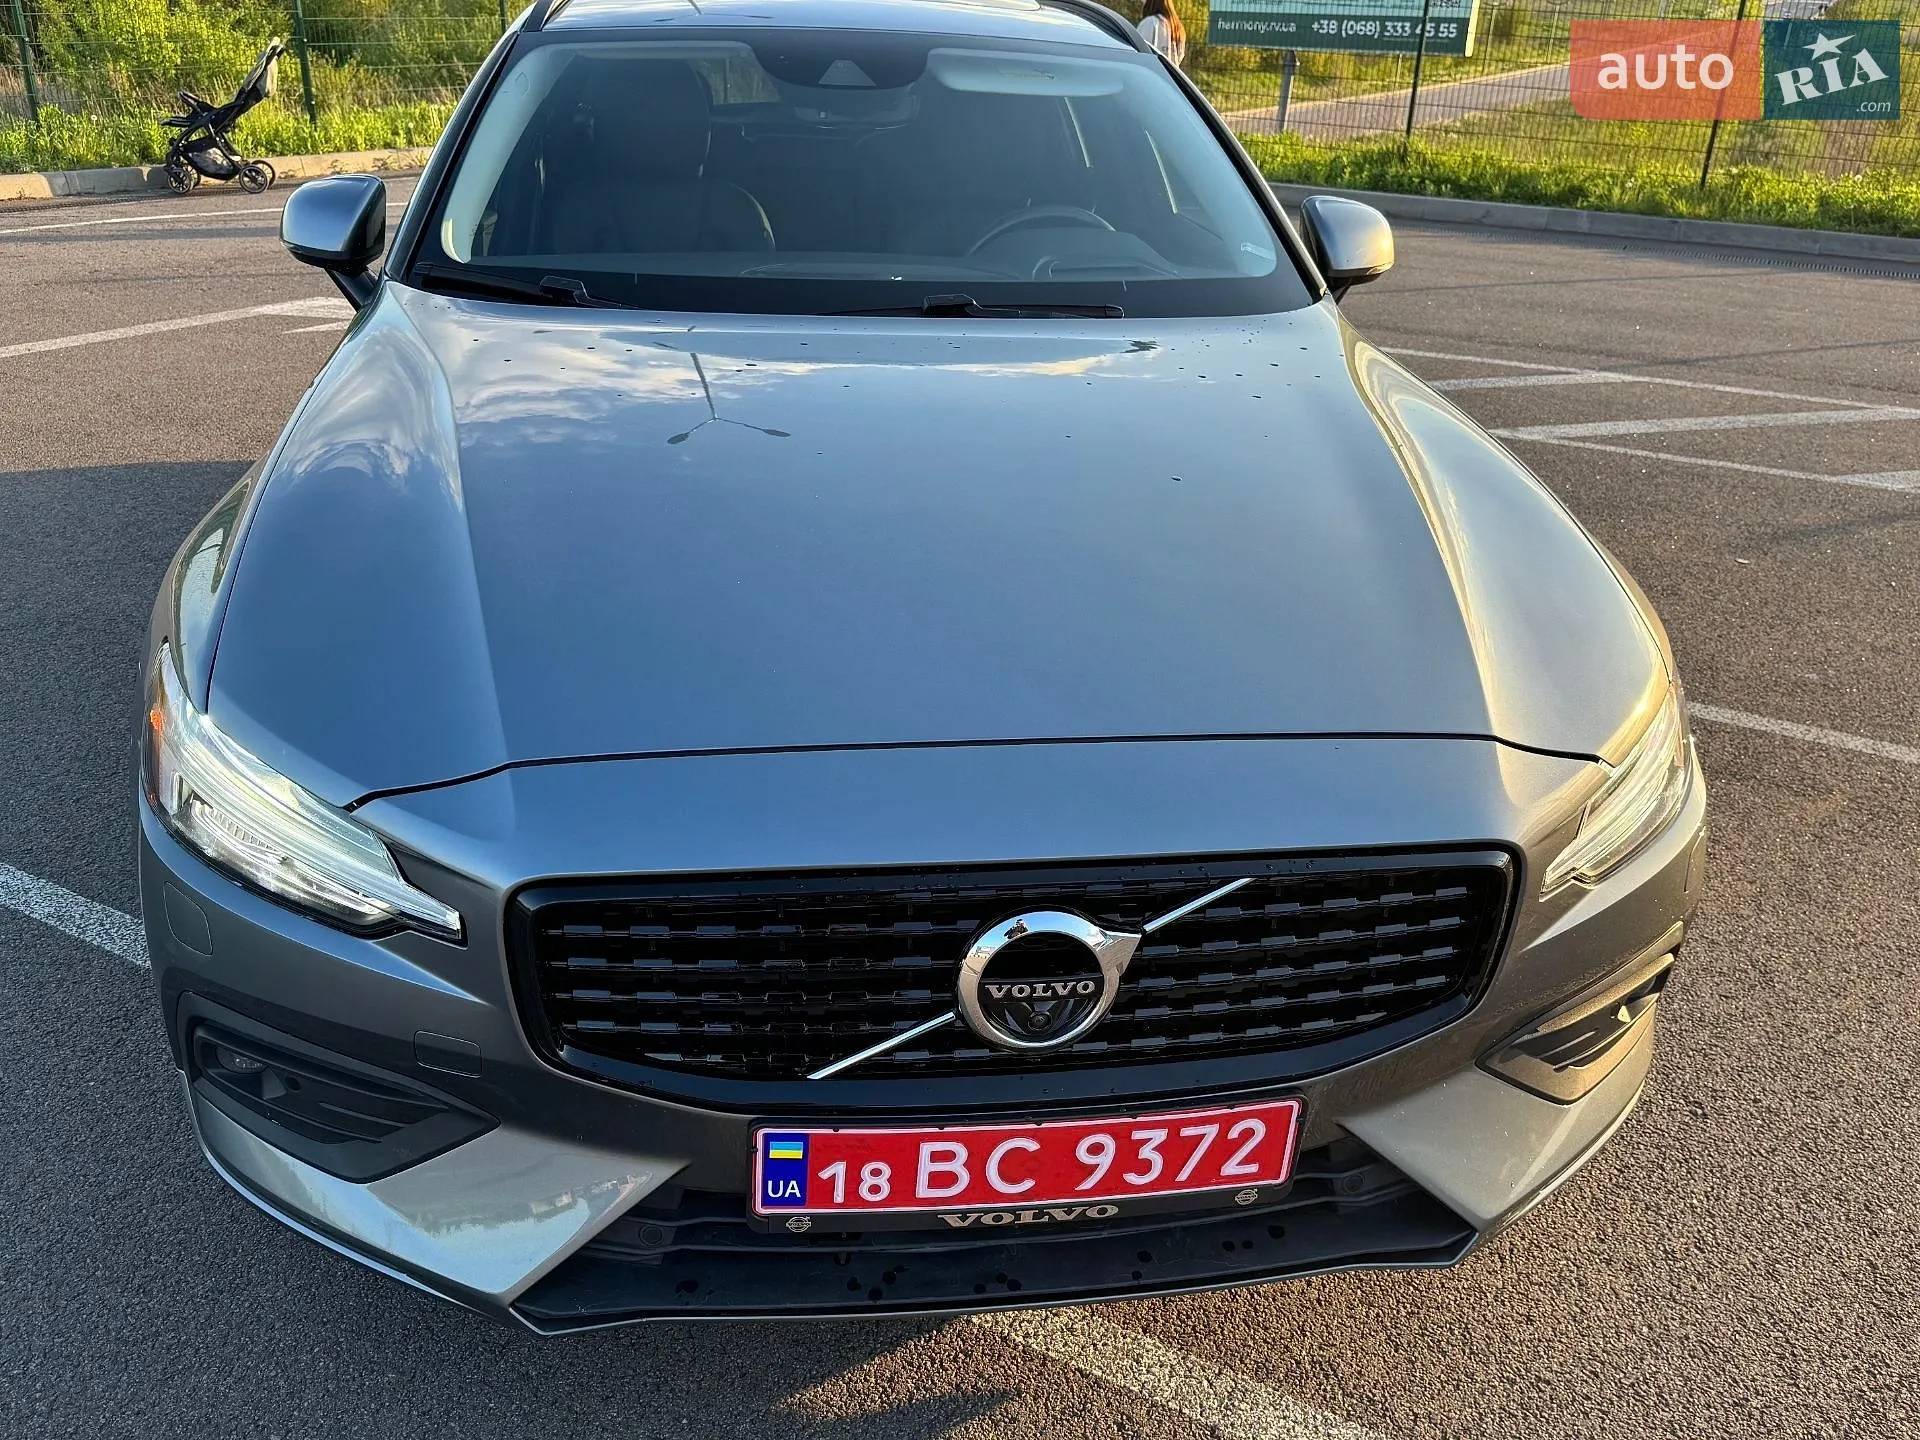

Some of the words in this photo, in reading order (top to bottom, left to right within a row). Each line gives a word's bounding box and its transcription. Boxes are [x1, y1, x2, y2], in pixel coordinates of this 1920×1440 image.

[1312, 20, 1338, 35] +38
[1342, 20, 1380, 39] (068)
[1384, 21, 1411, 38] 333
[1438, 23, 1458, 38] 55
[984, 980, 1096, 999] VOLVO
[817, 1160, 892, 1204] 18
[915, 1137, 1041, 1199] BC
[1074, 1118, 1267, 1192] 9372
[767, 1180, 802, 1198] UA
[937, 1204, 1119, 1229] VOLVO
